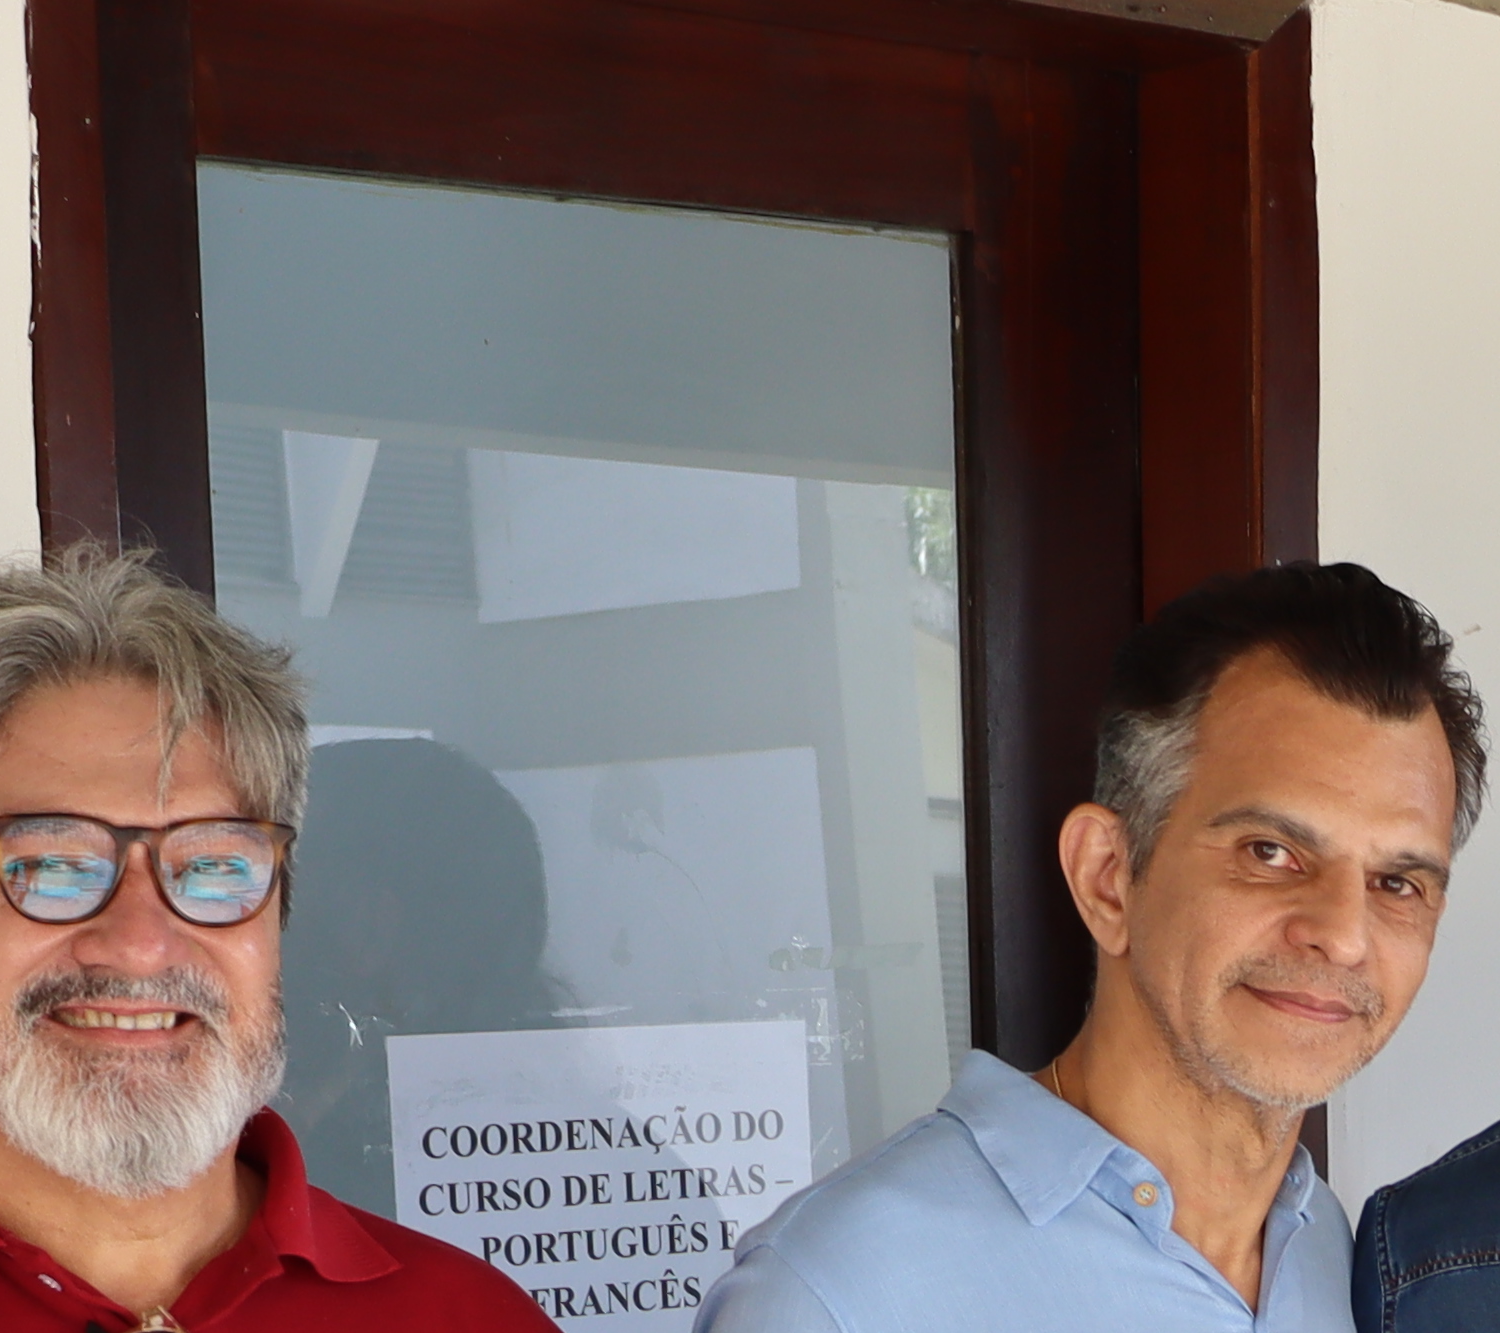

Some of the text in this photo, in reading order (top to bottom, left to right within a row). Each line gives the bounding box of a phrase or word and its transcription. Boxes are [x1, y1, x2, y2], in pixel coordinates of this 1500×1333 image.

[422, 1106, 785, 1159] COORDENAÇÃO DO
[418, 1177, 551, 1217] CURSO
[563, 1173, 613, 1207] DE
[622, 1164, 766, 1203] LETRAS
[480, 1214, 740, 1267] PORTUGUÊS E
[530, 1269, 702, 1319] FRANCÊS
